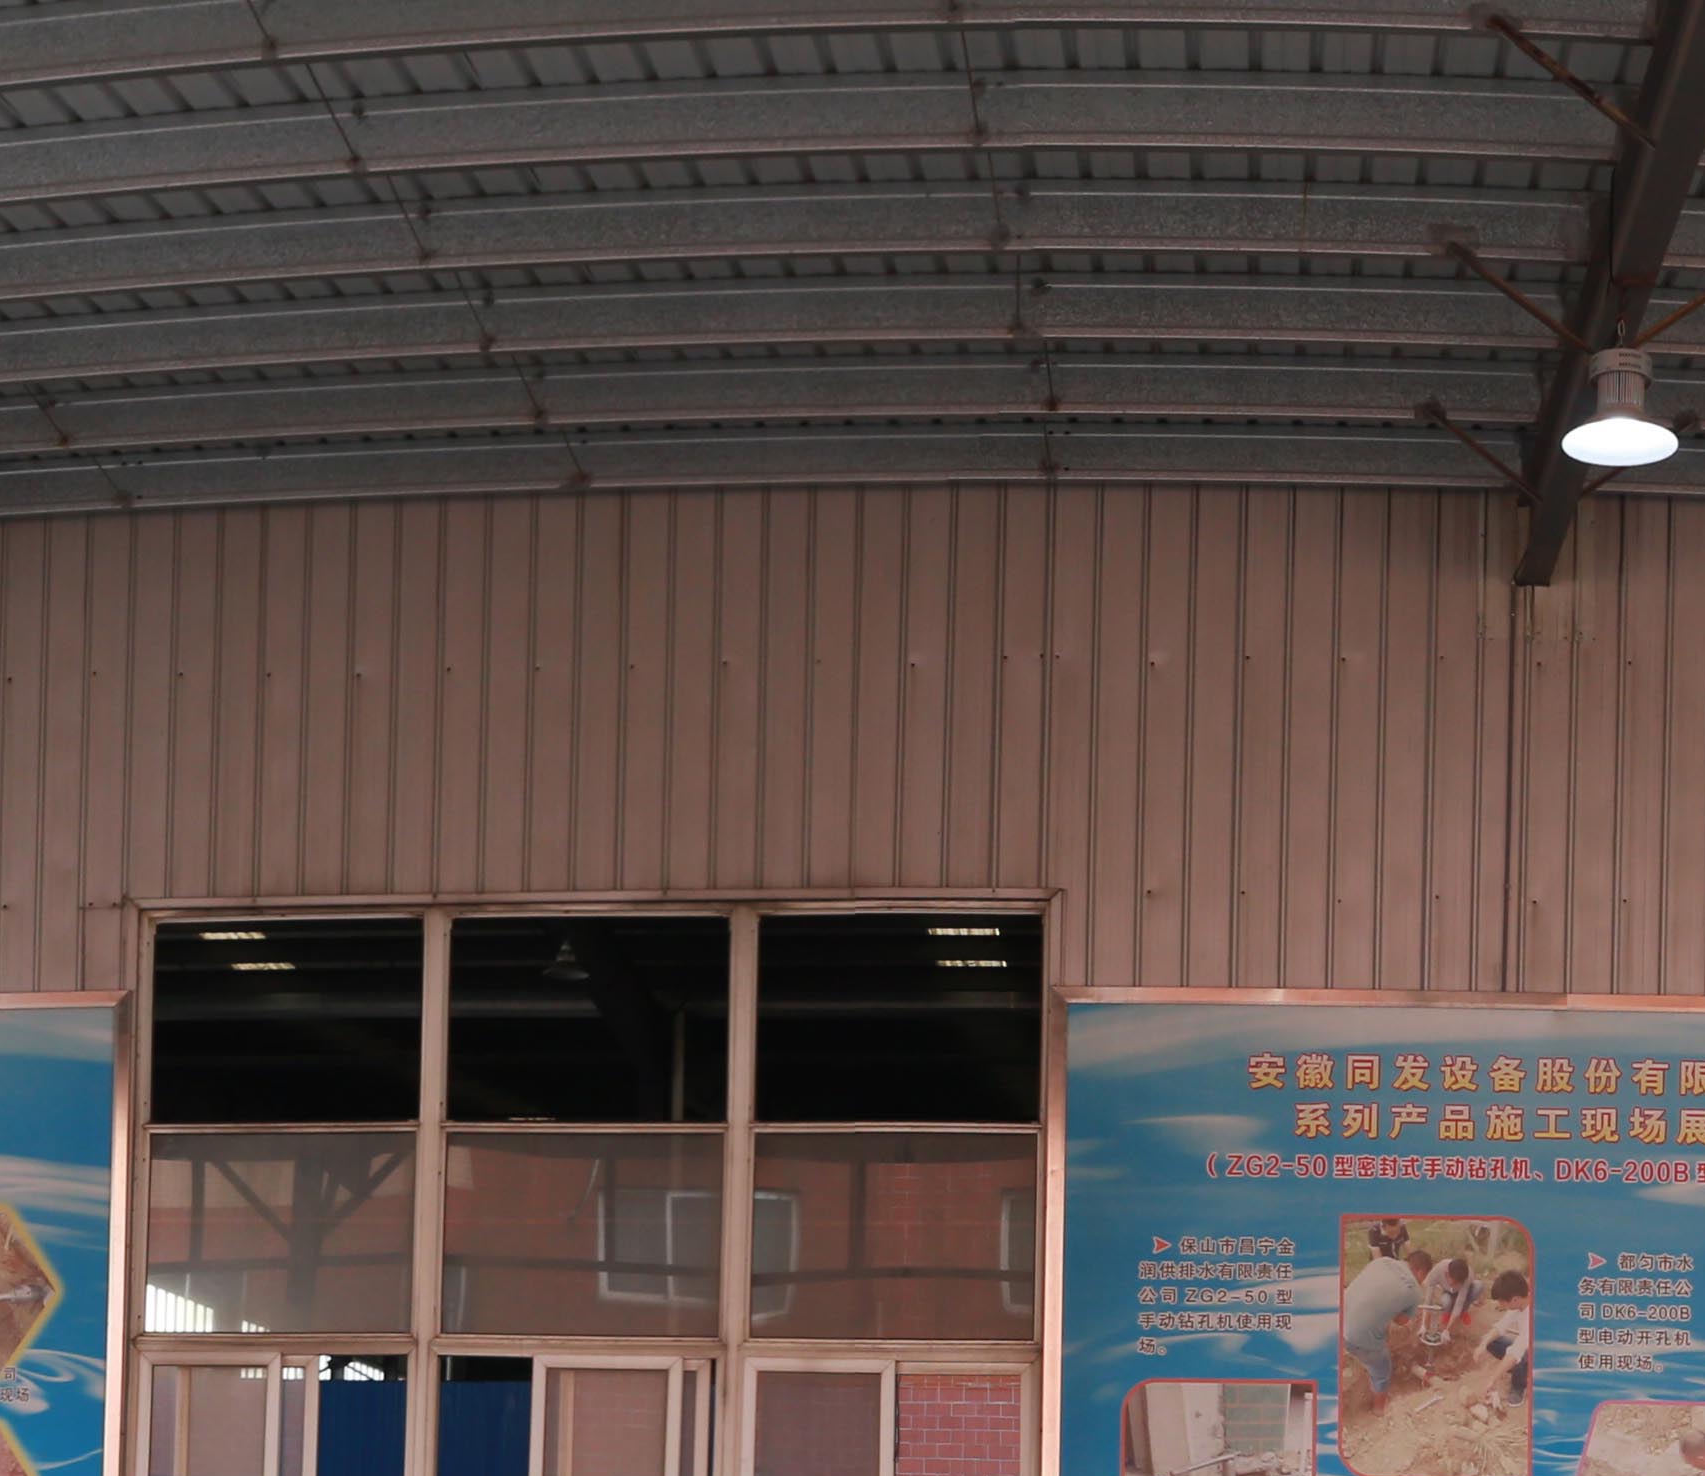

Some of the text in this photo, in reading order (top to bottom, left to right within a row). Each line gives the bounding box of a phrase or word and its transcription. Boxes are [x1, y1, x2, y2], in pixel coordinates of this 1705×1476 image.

[1180, 1237, 1295, 1256] 保山市昌宁金
[1139, 1260, 1294, 1280] 润供排水有限责任
[1619, 1253, 1694, 1272] 都匀市水
[1139, 1287, 1294, 1305] 公司 ZG2-50 型
[1579, 1277, 1692, 1297] 务有限责任公
[1139, 1312, 1293, 1331] 手动钻孔机使用现
[1579, 1303, 1691, 1321] 司 DK6-200B
[1139, 1338, 1167, 1355] 场。
[1579, 1327, 1691, 1347] 型电动开孔机
[1578, 1353, 1663, 1372] 使用现场。
